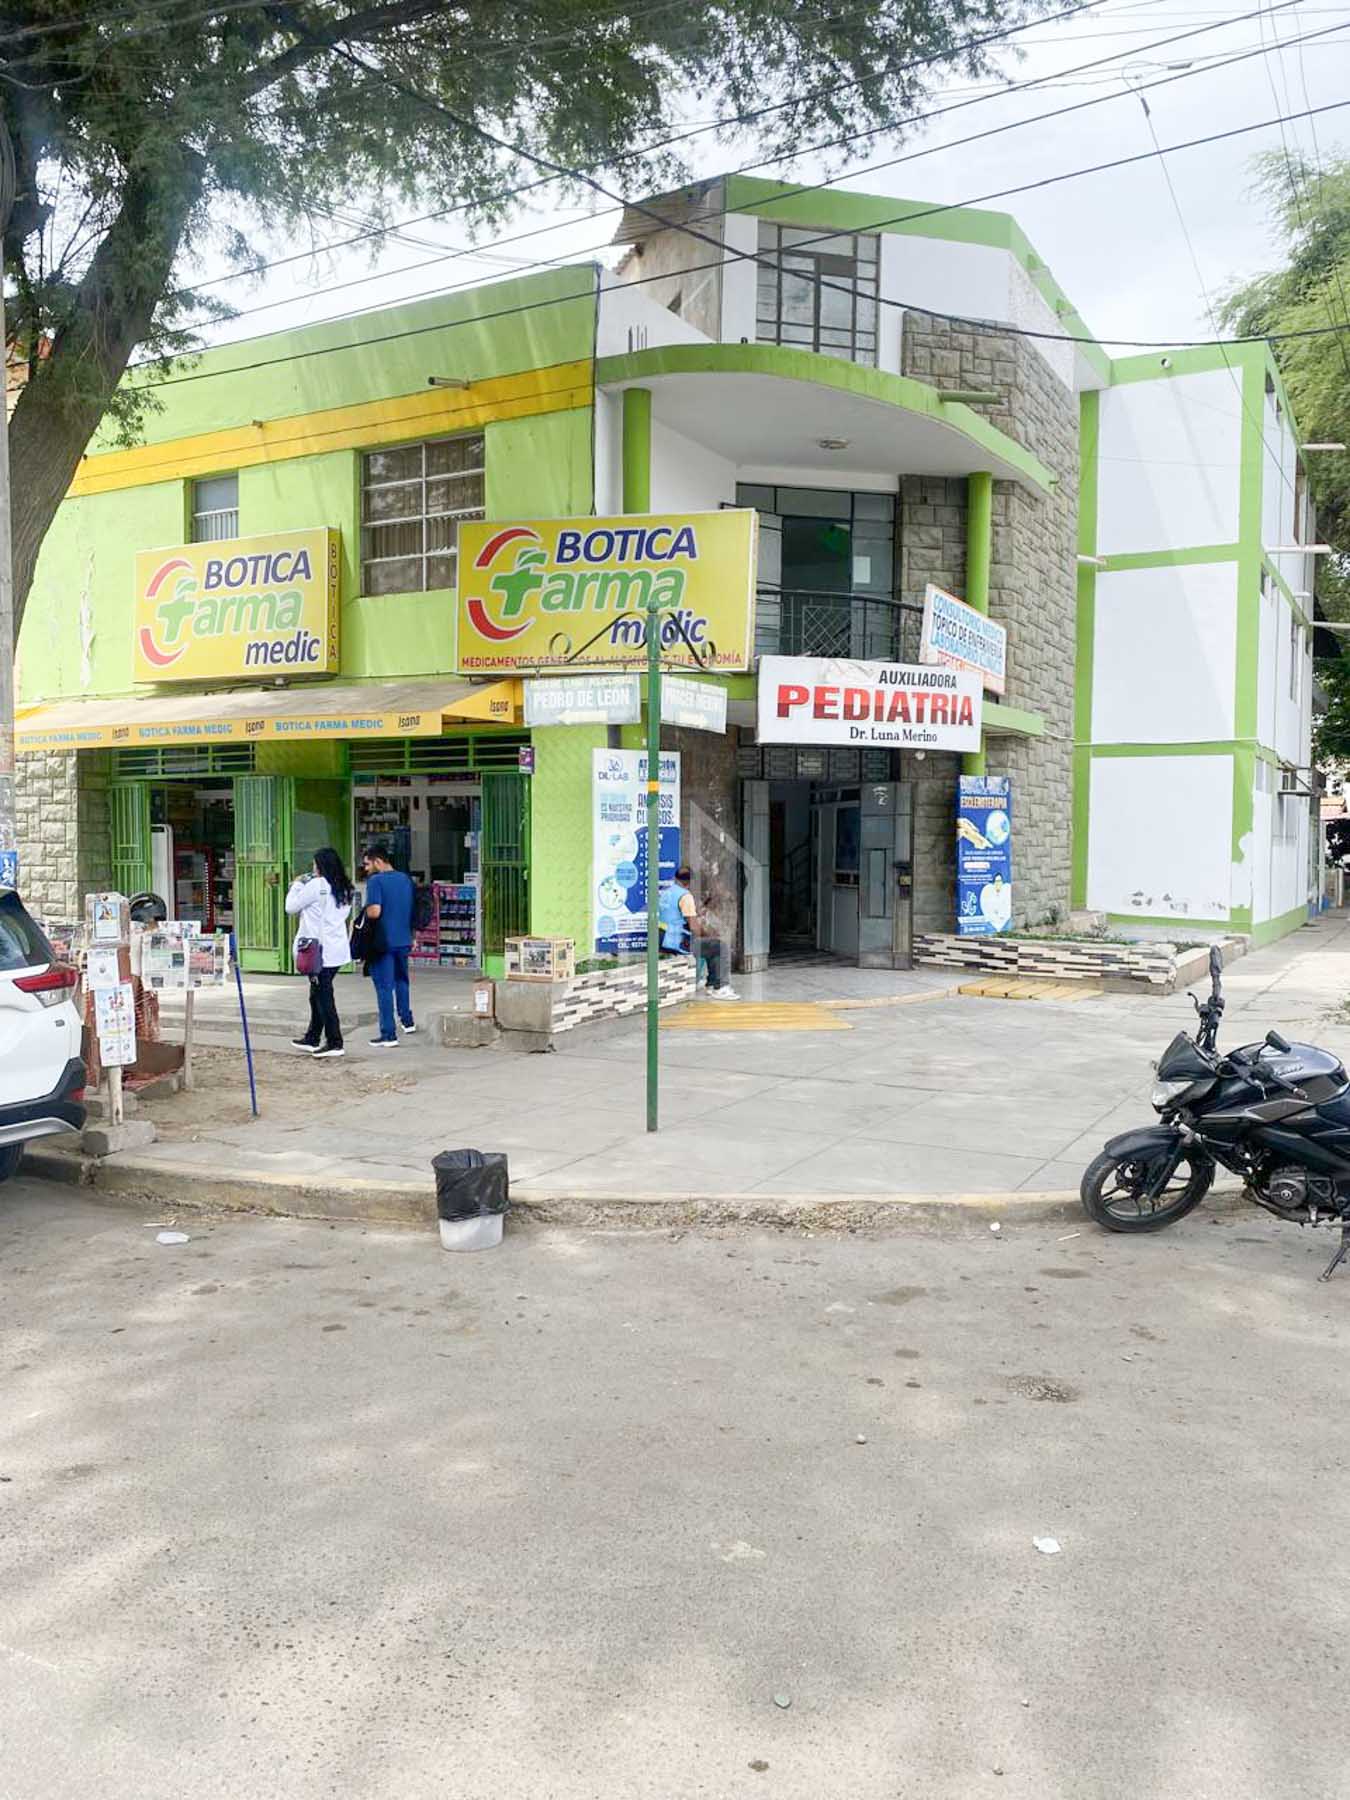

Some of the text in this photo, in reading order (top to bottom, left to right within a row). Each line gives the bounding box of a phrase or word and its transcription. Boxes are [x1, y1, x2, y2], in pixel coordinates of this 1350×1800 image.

[556, 528, 697, 563] BOTICA
[204, 550, 312, 589] BOTICA
[245, 631, 320, 664] medic
[879, 670, 957, 689] AUXILIADORA
[533, 690, 576, 708] PEDRO
[577, 690, 594, 707] DE
[777, 684, 974, 727] PEDIATRIA
[19, 735, 48, 745] BOTICA
[49, 734, 76, 743] FARMA
[77, 732, 103, 741] MEDIC
[138, 727, 171, 738] BOTICA
[172, 725, 202, 736] FARMA
[204, 723, 233, 735] MEDIC
[275, 720, 312, 732] BOTICA
[314, 719, 348, 731] FARMA
[351, 718, 384, 730] MEDIC
[849, 727, 938, 743] Dr. Luna Merino
